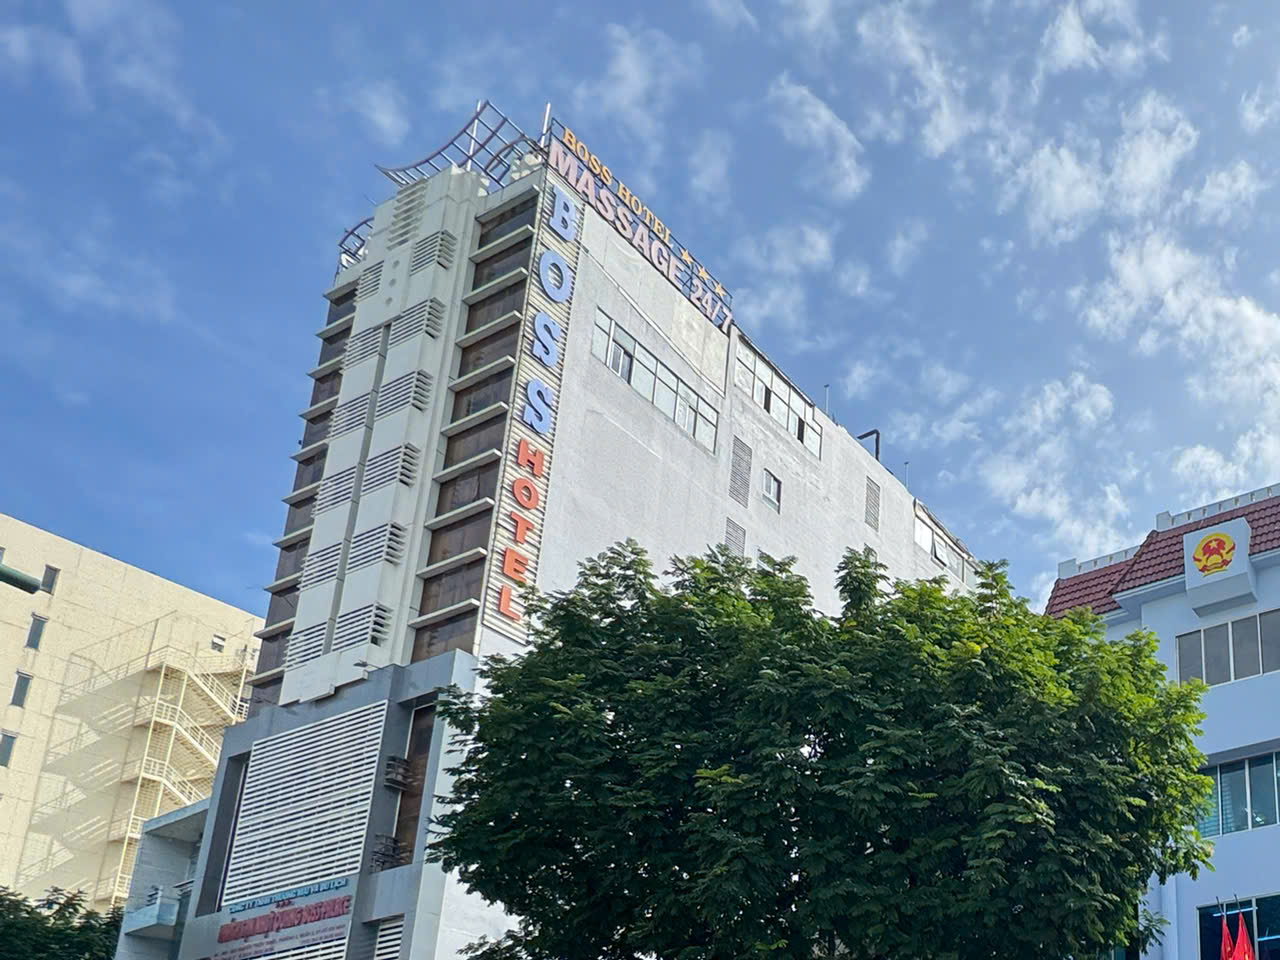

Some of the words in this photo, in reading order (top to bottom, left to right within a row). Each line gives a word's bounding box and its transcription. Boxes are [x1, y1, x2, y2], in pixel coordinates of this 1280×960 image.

[550, 141, 684, 288] MASSAGE
[689, 278, 733, 334] 24/7
[563, 127, 612, 185] BOSS
[618, 183, 674, 248] HOTEL
[522, 185, 578, 436] BOSS
[500, 438, 546, 621] HOTEL
